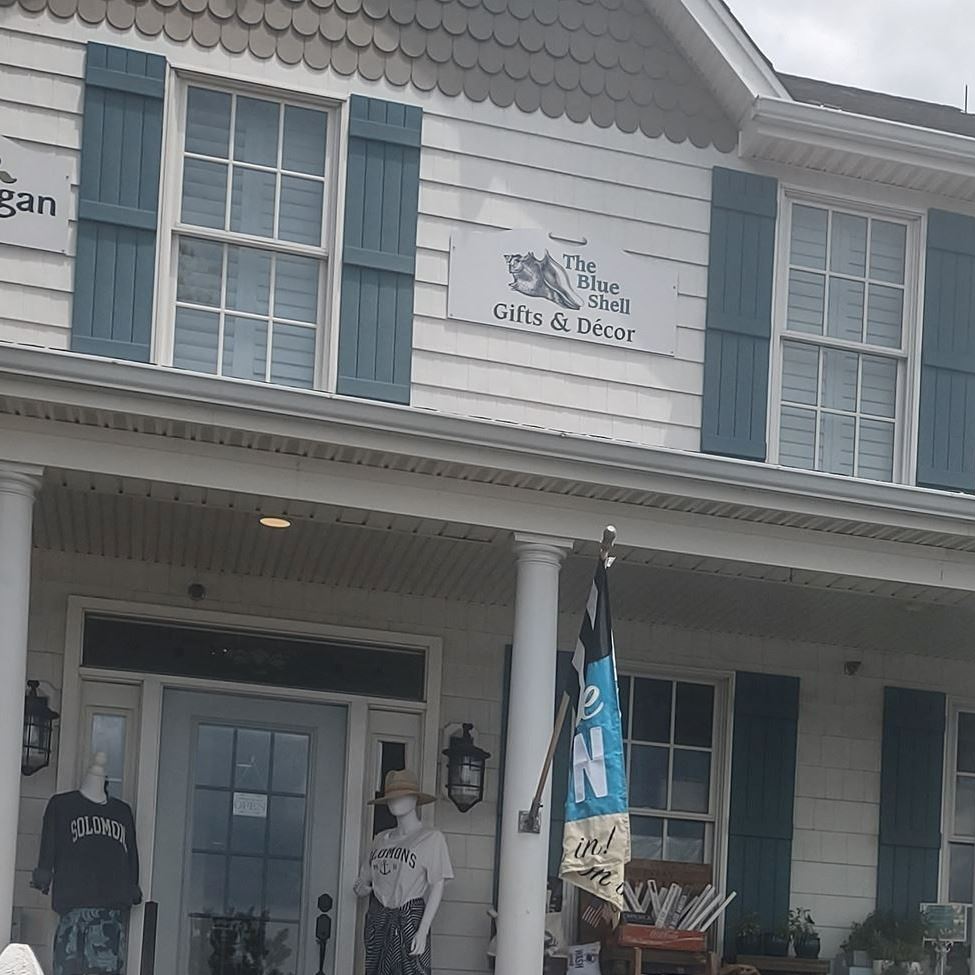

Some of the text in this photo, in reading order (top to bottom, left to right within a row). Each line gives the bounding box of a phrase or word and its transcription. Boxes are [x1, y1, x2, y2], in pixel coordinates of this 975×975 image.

[562, 253, 597, 274] The
[577, 274, 620, 295] Blue
[588, 294, 631, 315] Shell
[493, 303, 636, 343] Gifts & Décor
[574, 825, 617, 859] in!
